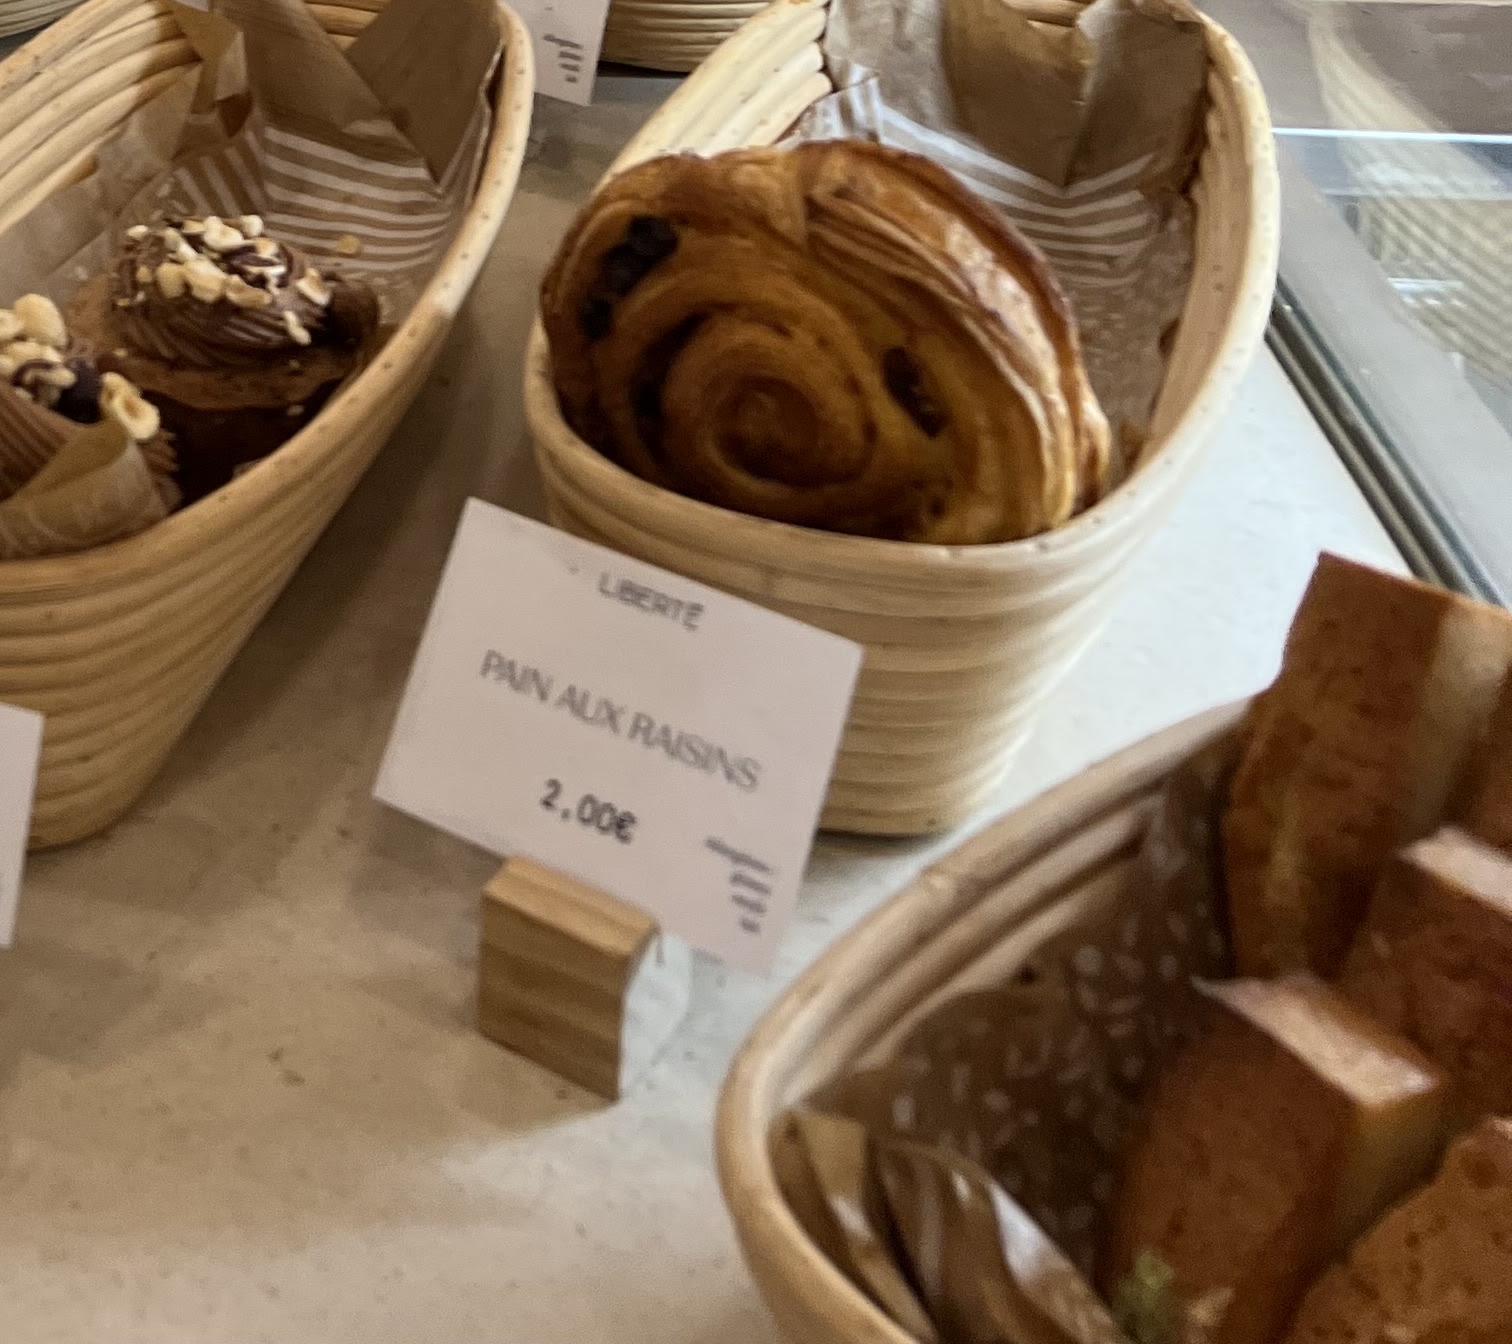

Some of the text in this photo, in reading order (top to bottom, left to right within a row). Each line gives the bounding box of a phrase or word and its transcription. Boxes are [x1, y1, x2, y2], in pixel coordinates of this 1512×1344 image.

[599, 572, 704, 633] LIBERTÉ
[480, 650, 763, 792] PAIN AUX RAISINS
